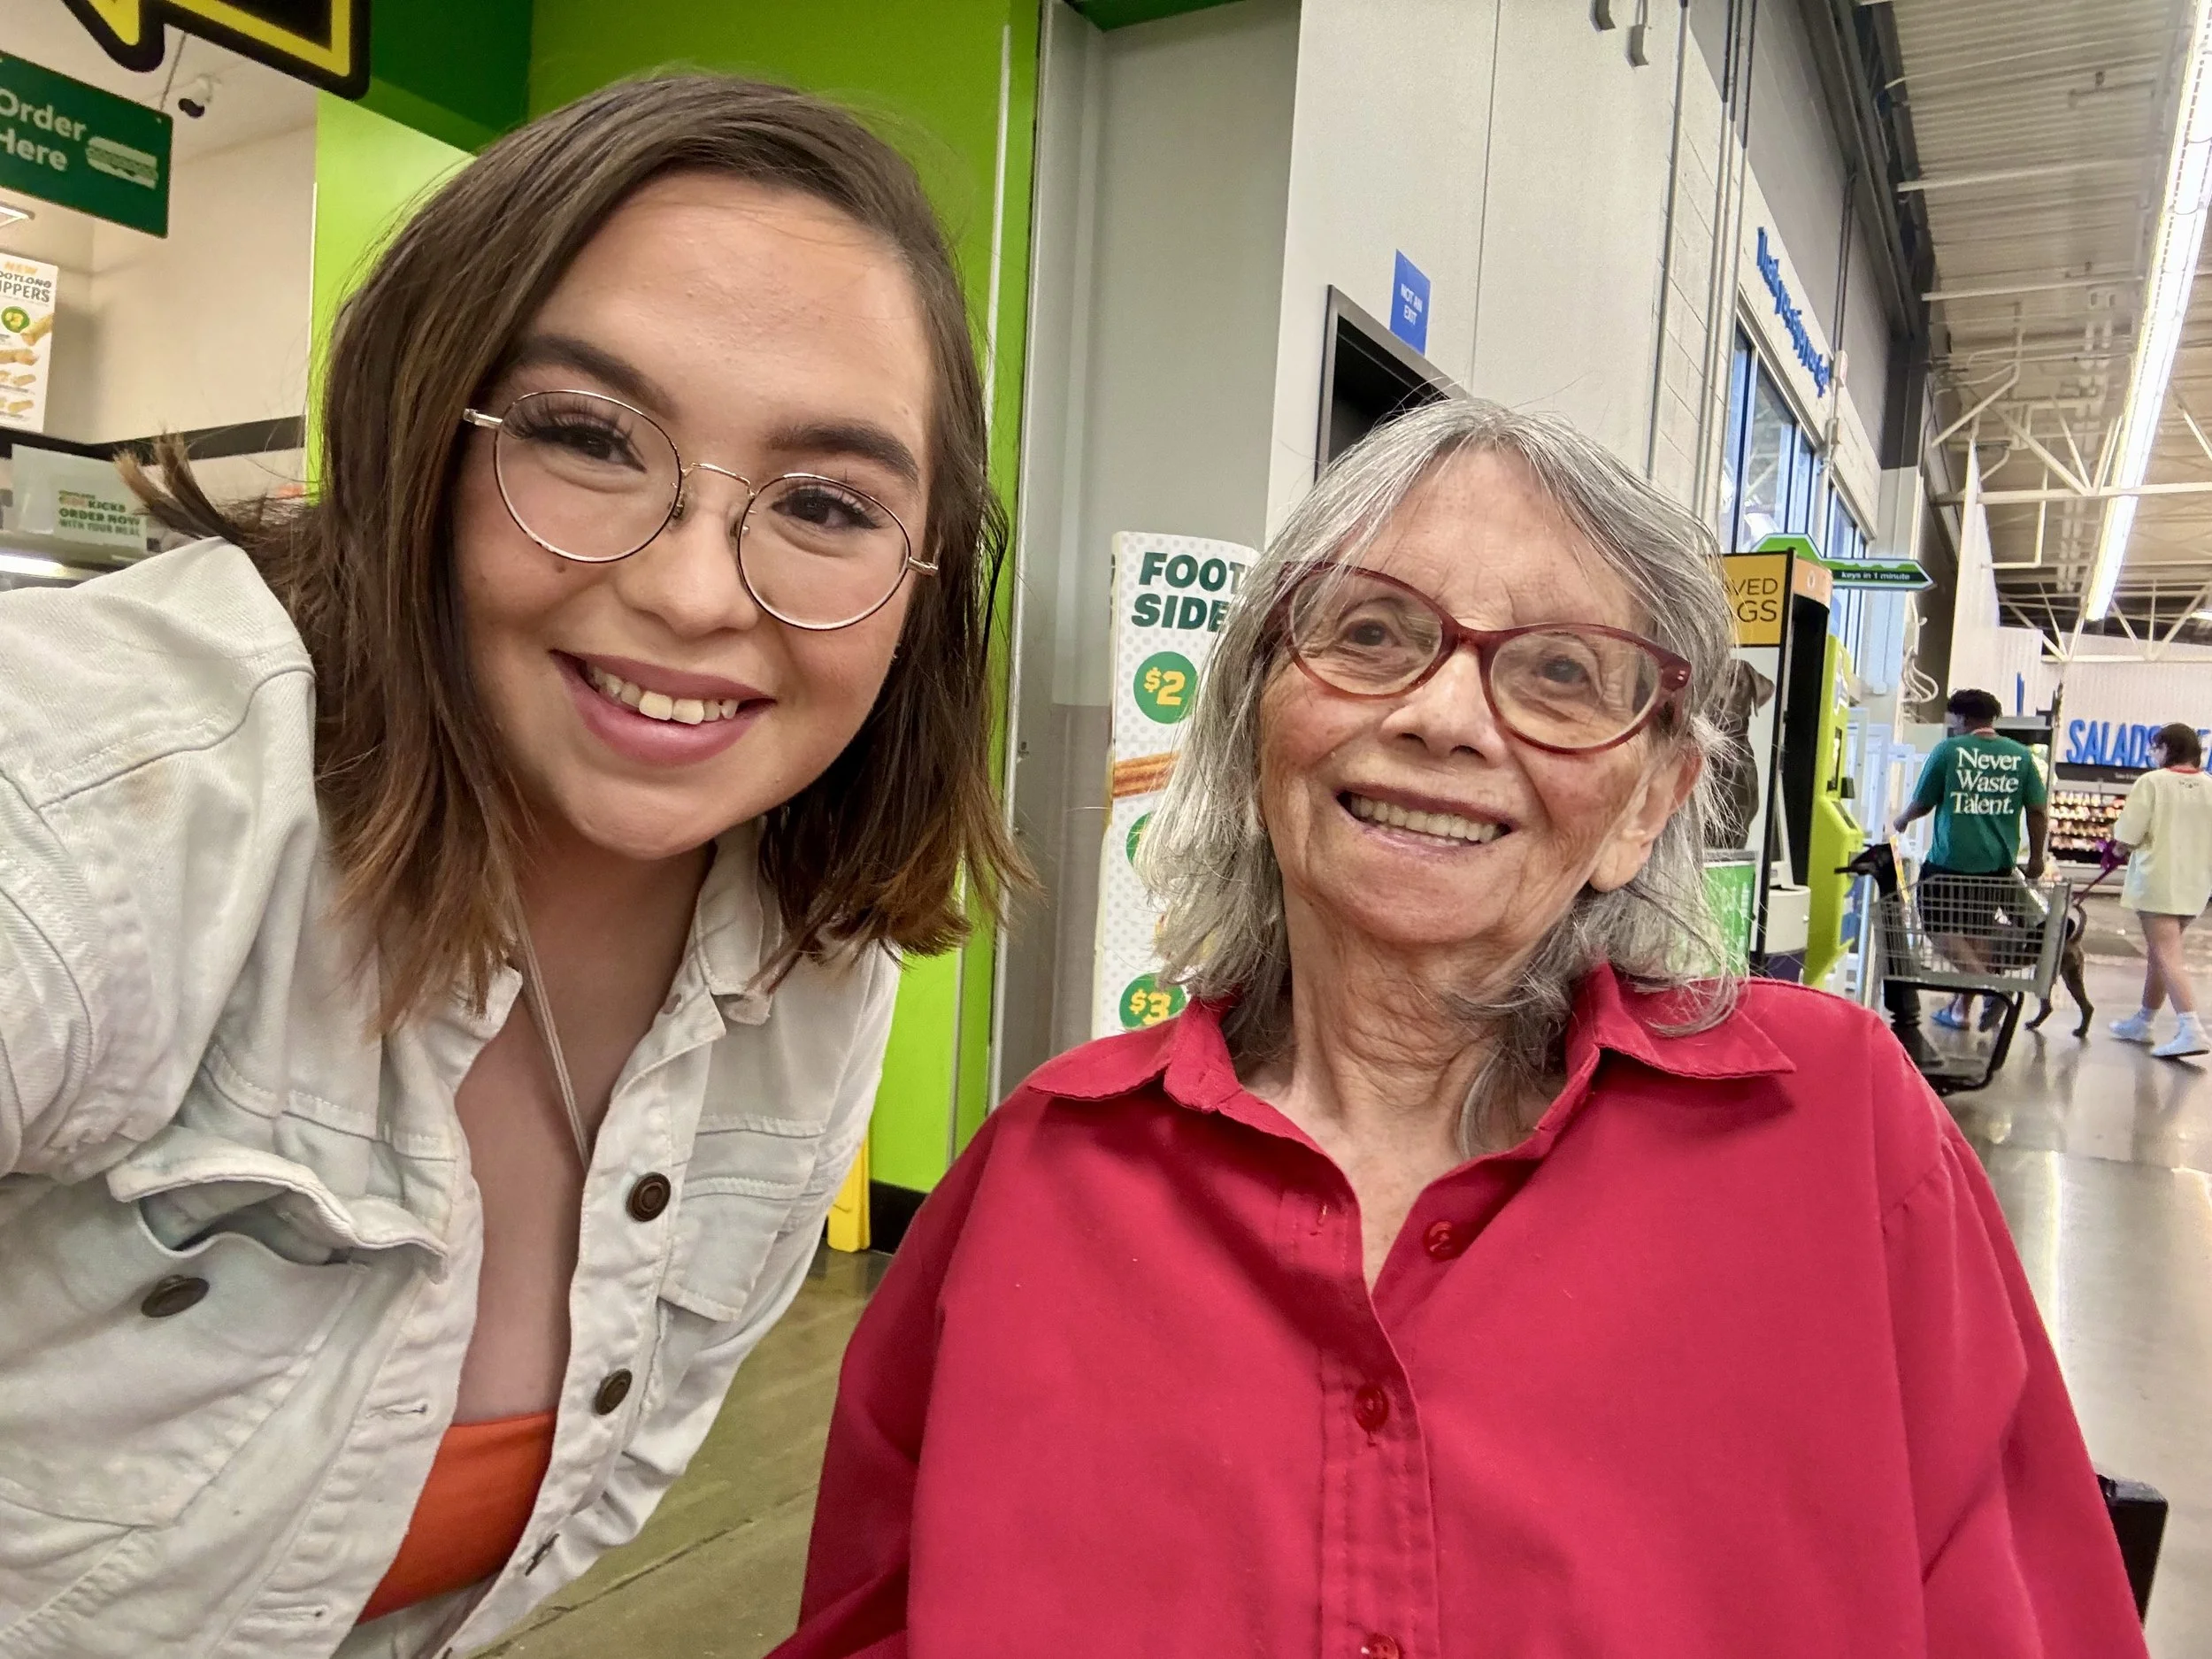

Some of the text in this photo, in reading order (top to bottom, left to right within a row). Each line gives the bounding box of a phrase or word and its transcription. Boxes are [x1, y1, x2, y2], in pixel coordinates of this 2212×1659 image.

[0, 88, 87, 142] Order
[0, 127, 68, 172] Here
[59, 508, 140, 525] ORDER NOW
[1841, 572, 1861, 580] keys
[1143, 666, 1186, 706] $2
[1956, 747, 2022, 771] Never
[1955, 769, 2019, 794] Waste
[1950, 791, 2014, 815] Talent.
[1128, 987, 1172, 1026] $3
